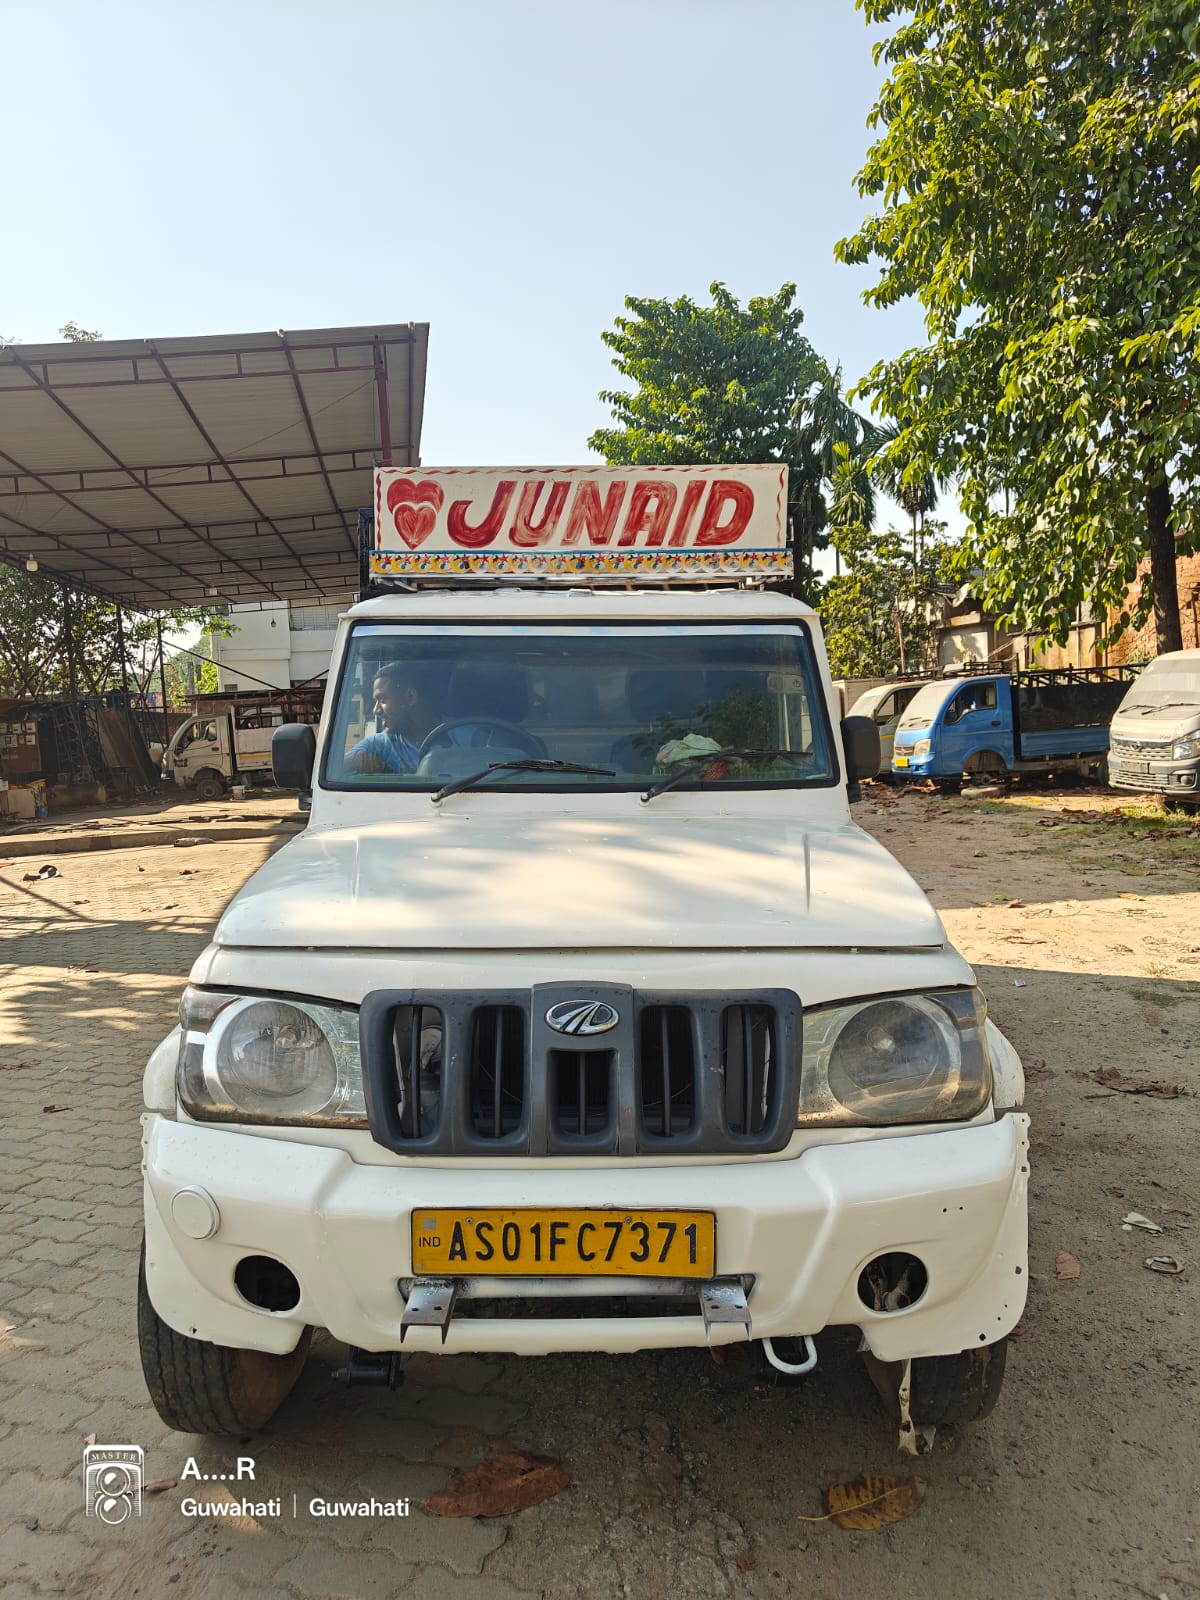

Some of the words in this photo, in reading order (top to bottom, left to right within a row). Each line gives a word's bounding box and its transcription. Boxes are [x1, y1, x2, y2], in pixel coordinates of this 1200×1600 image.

[446, 479, 755, 548] JUNAID
[418, 1236, 441, 1248] IND
[448, 1221, 697, 1264] AS01FC7371
